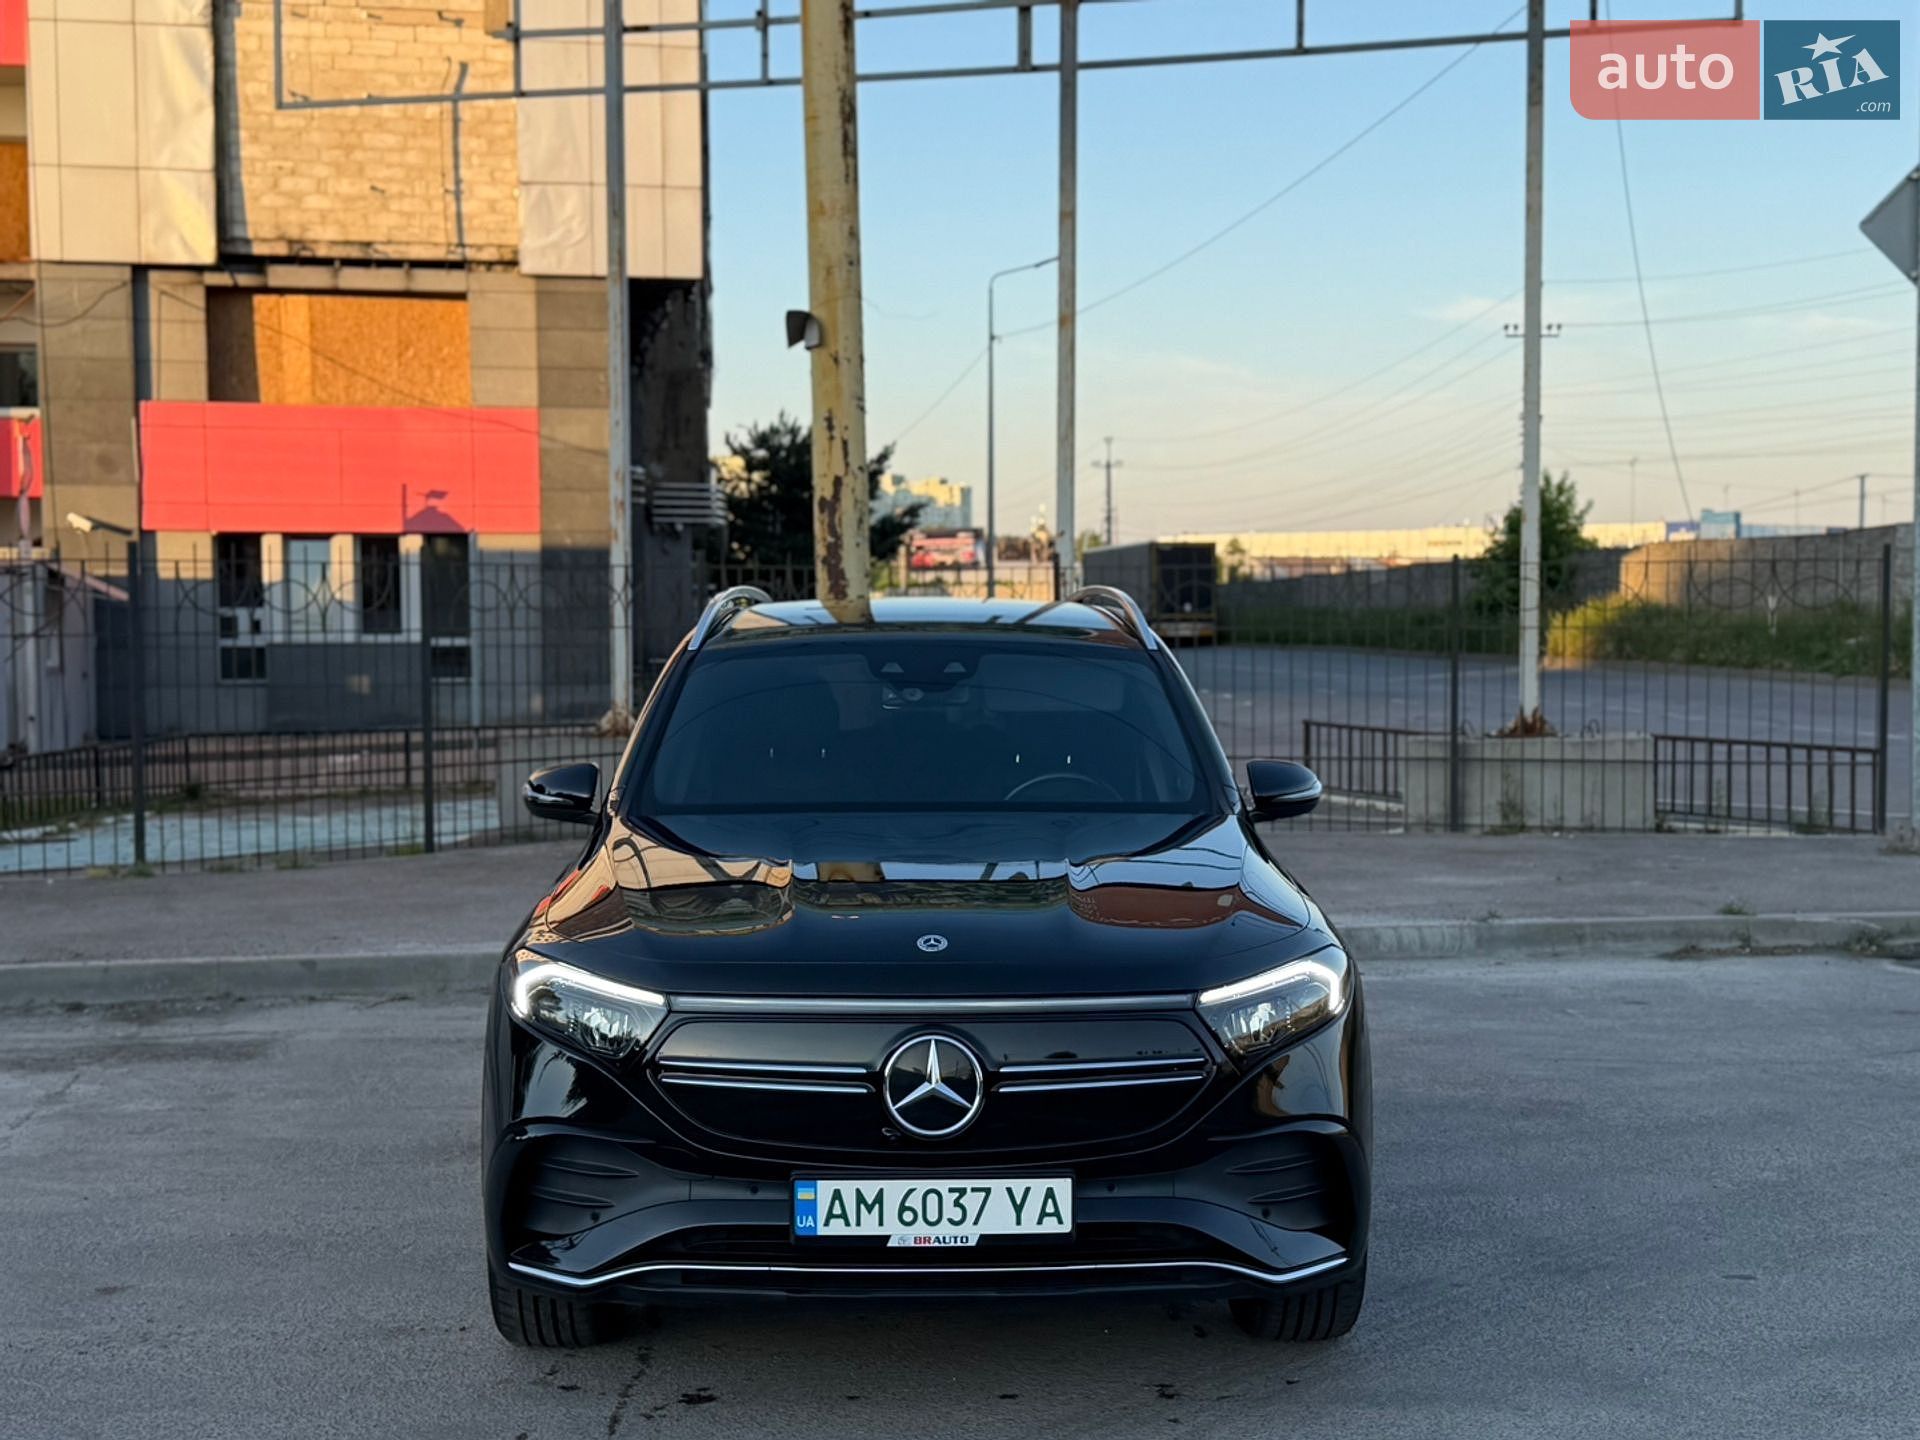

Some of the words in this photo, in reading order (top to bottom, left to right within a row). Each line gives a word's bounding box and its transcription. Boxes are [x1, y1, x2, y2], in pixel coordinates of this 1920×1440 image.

[822, 1187, 885, 1228] AM
[896, 1186, 993, 1228] 6037
[1005, 1186, 1065, 1227] YA
[796, 1215, 816, 1228] UA
